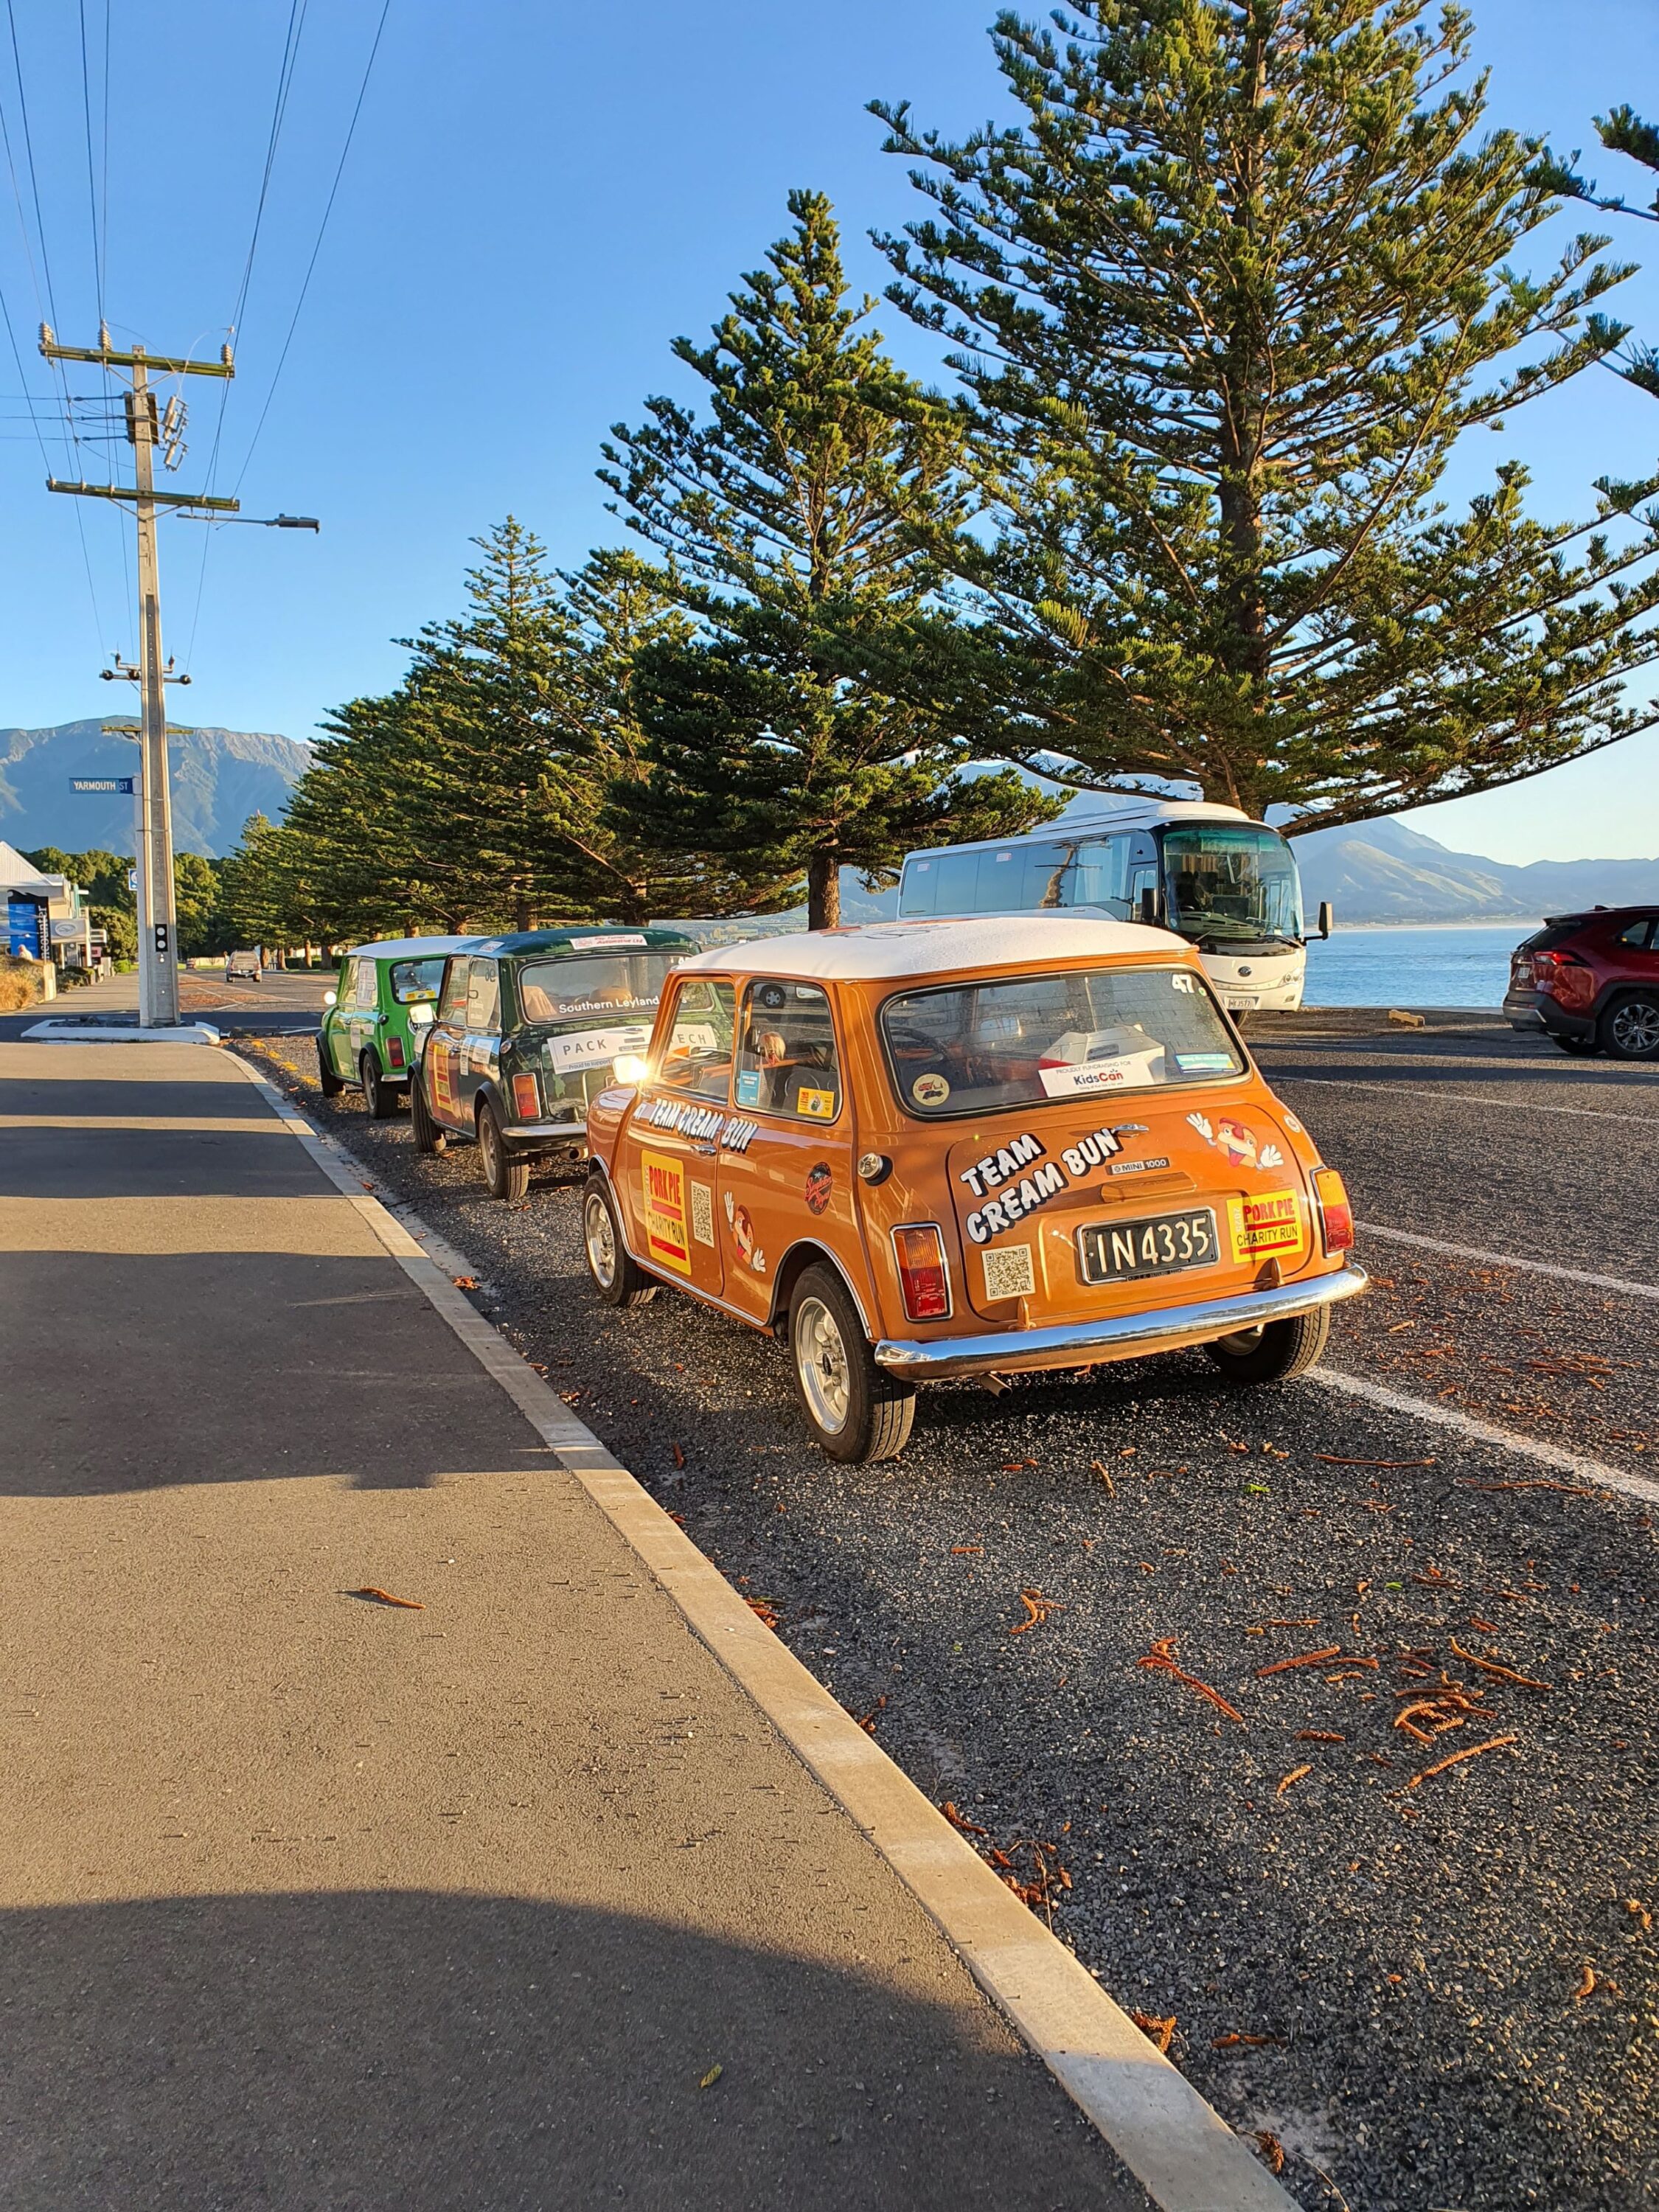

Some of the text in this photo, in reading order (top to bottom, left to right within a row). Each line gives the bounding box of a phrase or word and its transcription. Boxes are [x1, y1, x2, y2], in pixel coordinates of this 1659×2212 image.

[74, 781, 128, 790] YARMOUTH ST
[38, 905, 49, 959] ncounter
[1172, 974, 1194, 993] 47
[559, 995, 659, 1014] Southern Leyland
[563, 1034, 706, 1056] PACK ECH
[1056, 1066, 1081, 1074] PROUDLY
[1082, 1062, 1119, 1071] FUNDRAISING
[1074, 1069, 1124, 1085] KidsCan
[649, 1098, 682, 1129] TEAM
[677, 1105, 724, 1140] CREAM
[721, 1116, 758, 1151] BUN
[960, 1133, 1044, 1197] TEAM
[1121, 1159, 1166, 1172] MINI 1000
[649, 1166, 669, 1201] PORK
[668, 1172, 681, 1206] PIE
[967, 1127, 1120, 1243] CREAM BUN
[1244, 1198, 1295, 1222] PORK PIE
[648, 1211, 685, 1246] CHARITY RUN
[1237, 1225, 1298, 1247] CHARITY RUN
[1096, 1217, 1209, 1273] IN4335
